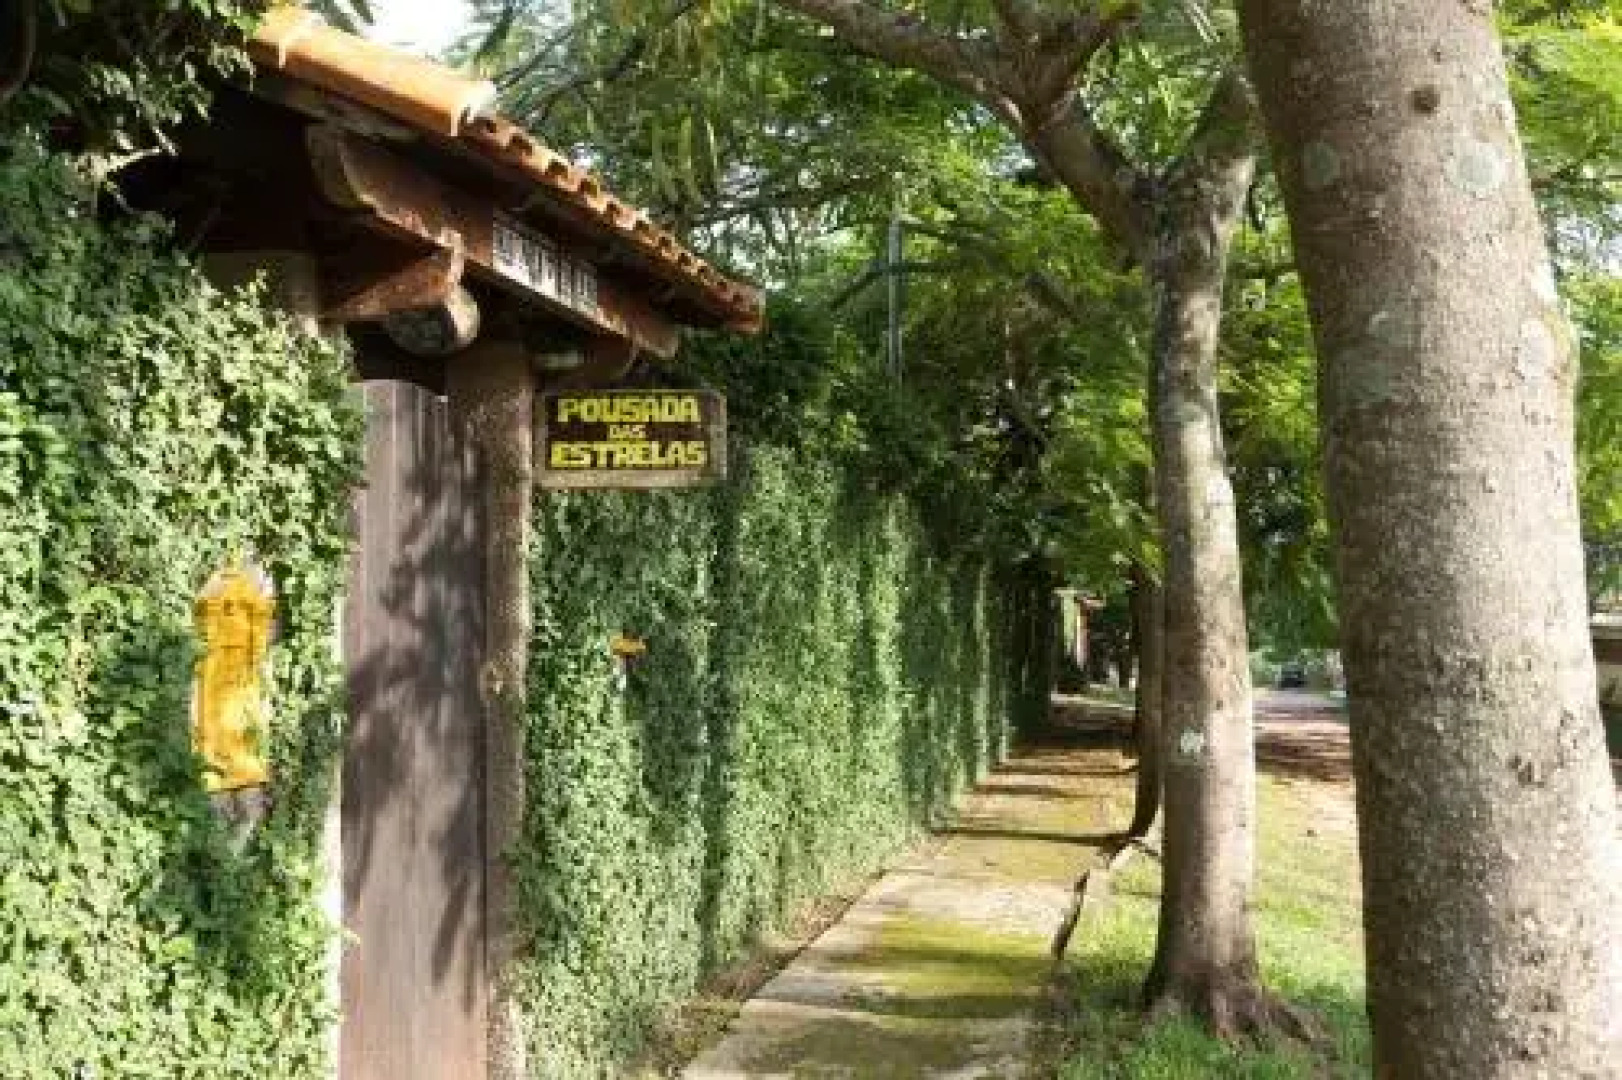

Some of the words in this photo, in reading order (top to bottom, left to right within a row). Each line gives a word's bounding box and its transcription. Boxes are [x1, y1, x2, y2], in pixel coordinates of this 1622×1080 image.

[558, 396, 701, 422] POUSADA
[609, 424, 646, 438] DAS
[551, 441, 707, 467] ESTRELAS
